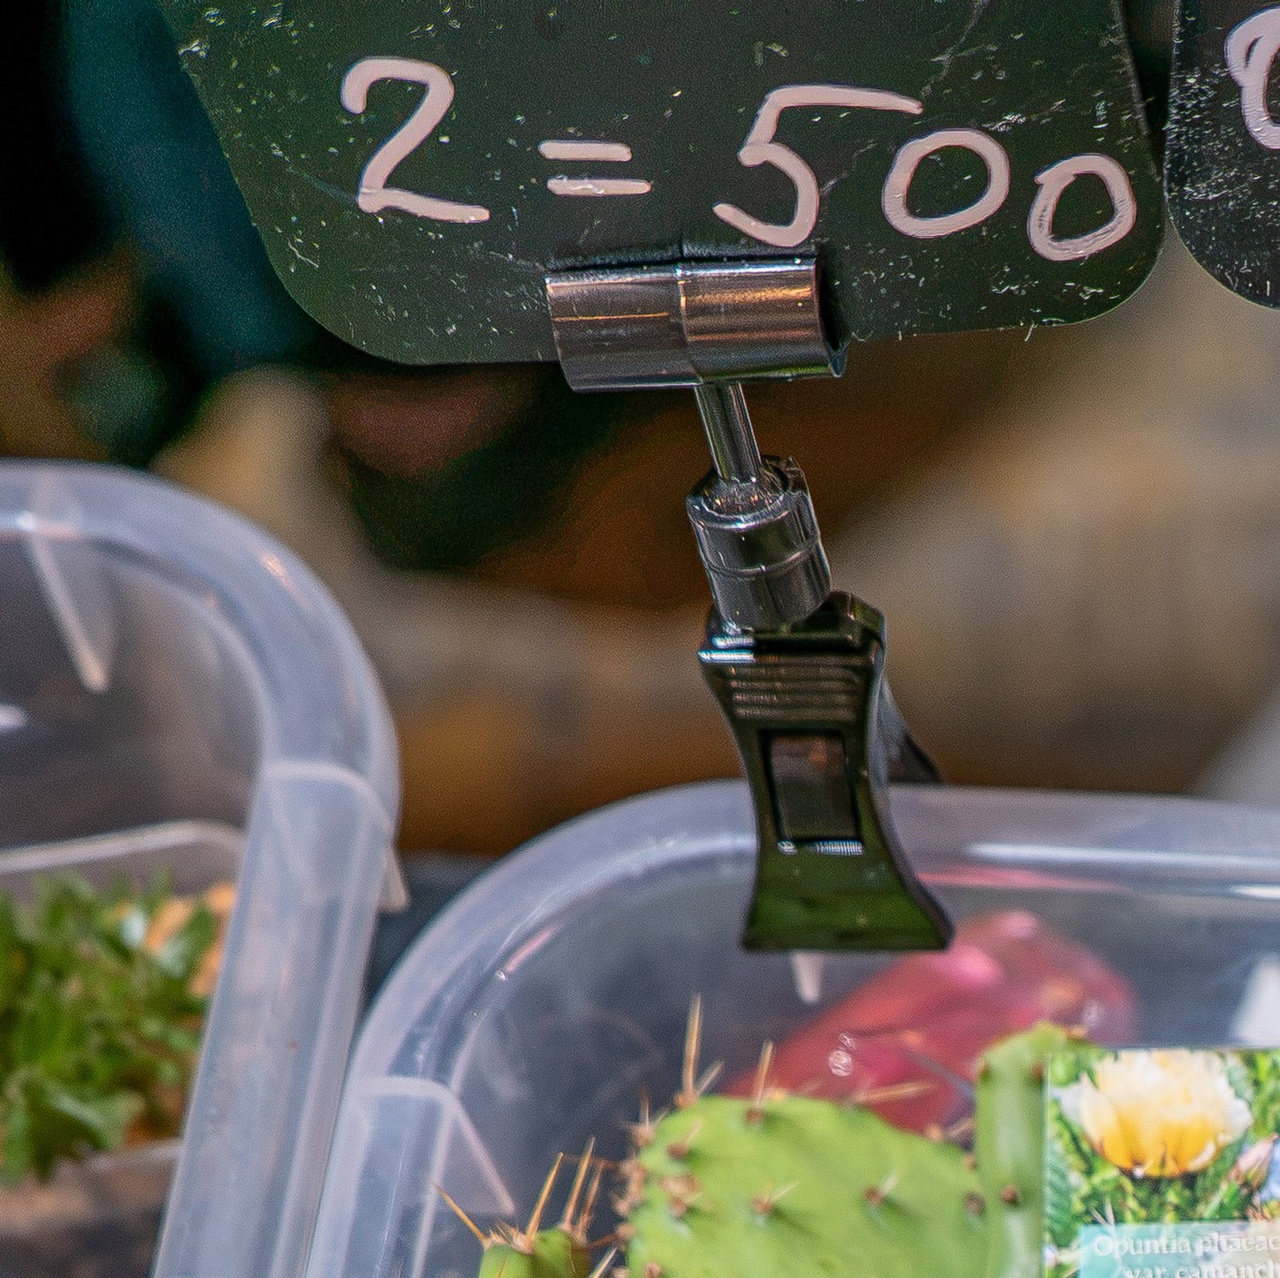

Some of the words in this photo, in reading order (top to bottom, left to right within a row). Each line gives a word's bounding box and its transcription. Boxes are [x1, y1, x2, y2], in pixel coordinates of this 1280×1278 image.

[341, 57, 491, 225] 2
[538, 139, 652, 197] =
[711, 84, 1135, 262] 500
[1094, 1232, 1192, 1259] Opuntia
